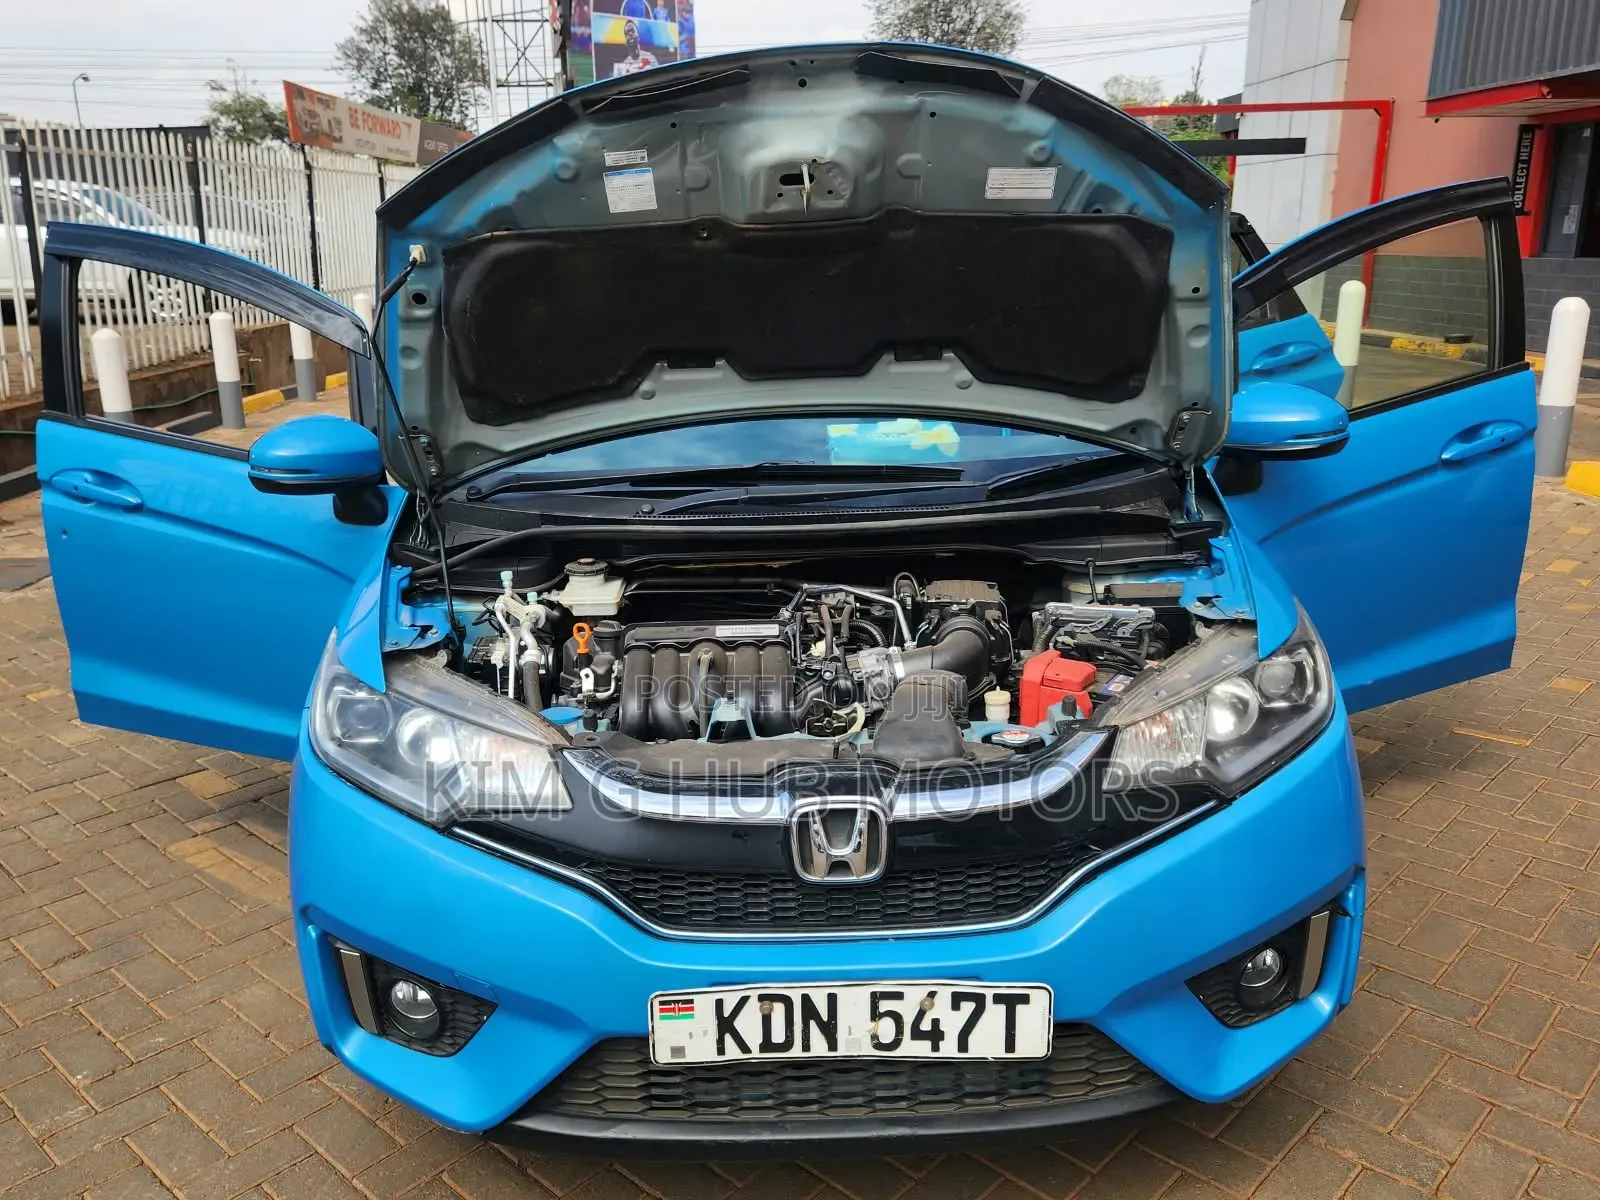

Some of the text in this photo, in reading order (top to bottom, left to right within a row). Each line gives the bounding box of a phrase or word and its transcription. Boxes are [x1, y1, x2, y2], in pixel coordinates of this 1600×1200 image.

[348, 106, 401, 139] BE FORWARD
[1513, 131, 1533, 209] COLLECT HERE
[715, 992, 838, 1056] KDN
[870, 990, 1031, 1054] 547T
